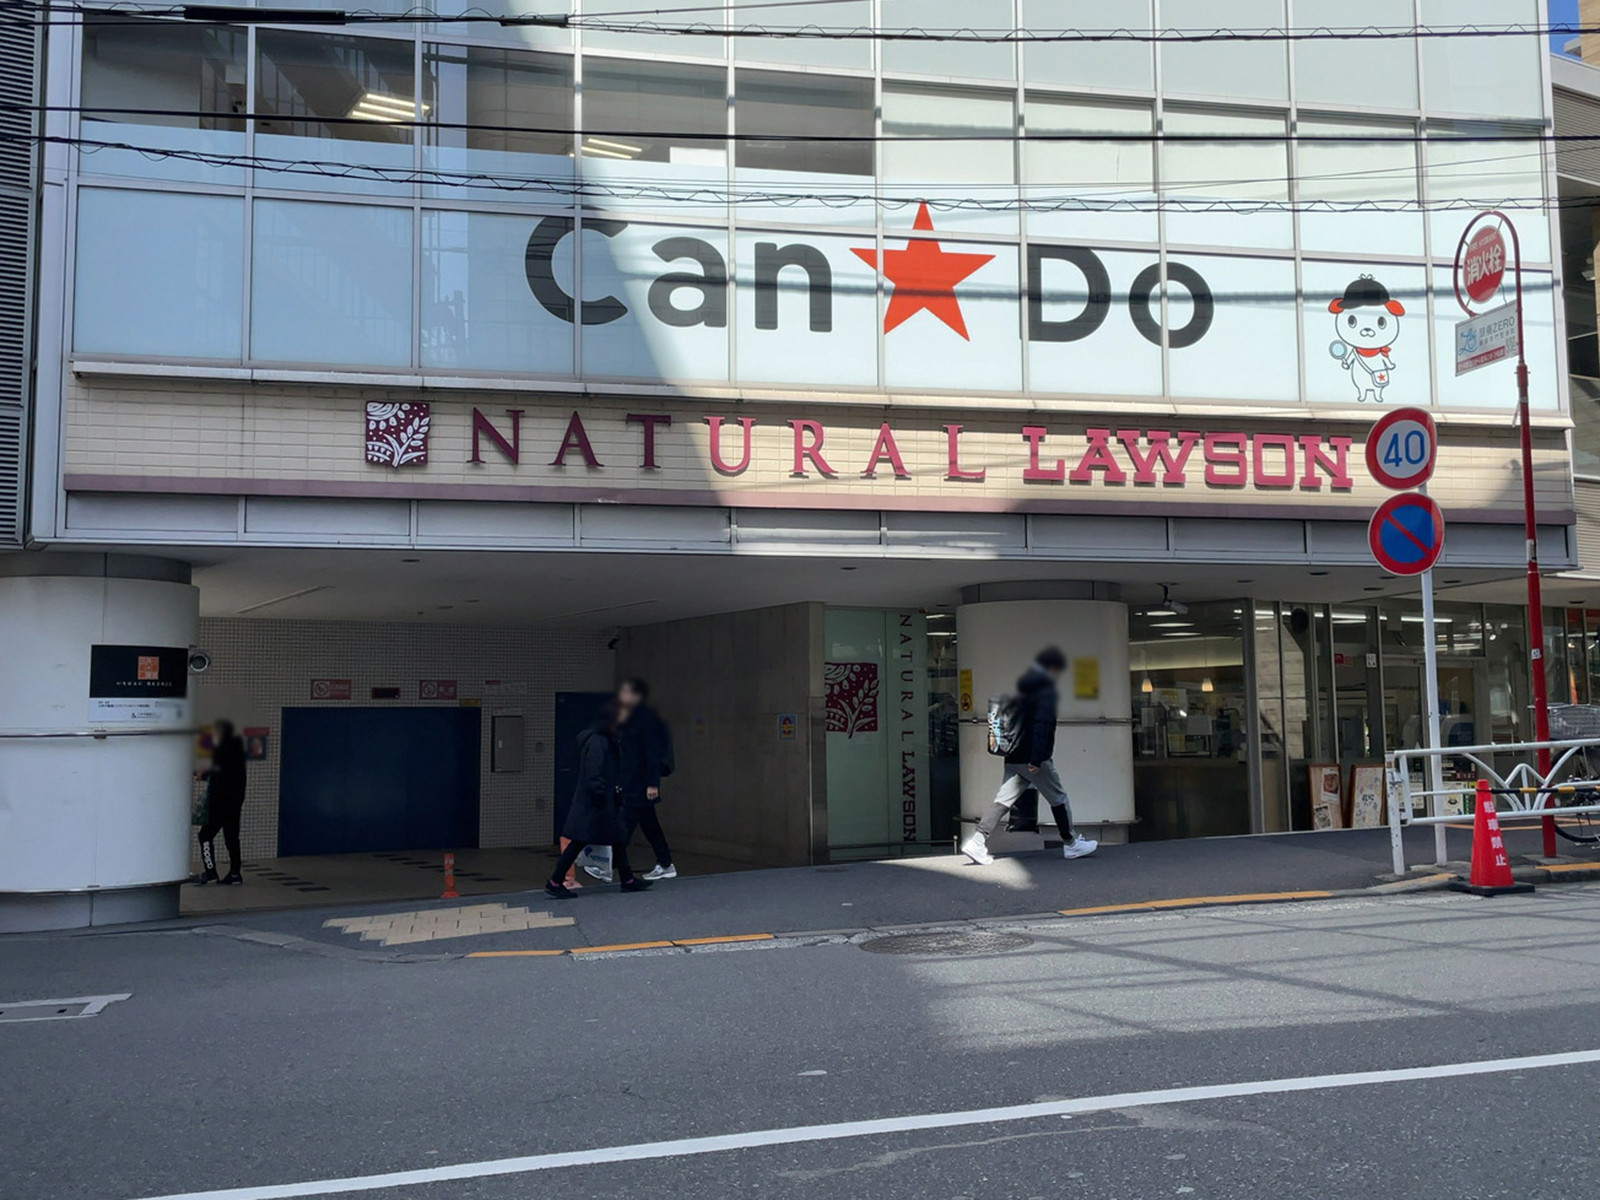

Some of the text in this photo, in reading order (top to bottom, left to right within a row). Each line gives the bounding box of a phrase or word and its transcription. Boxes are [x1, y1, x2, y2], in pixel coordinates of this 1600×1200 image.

[525, 206, 1214, 348] Can Do
[1467, 243, 1503, 287] 消火栓
[466, 406, 1354, 491] NATURAL LAWSON
[1383, 429, 1426, 468] 40
[900, 614, 917, 842] NATURAL LAWSON
[1483, 800, 1507, 867] 駐車禁止
